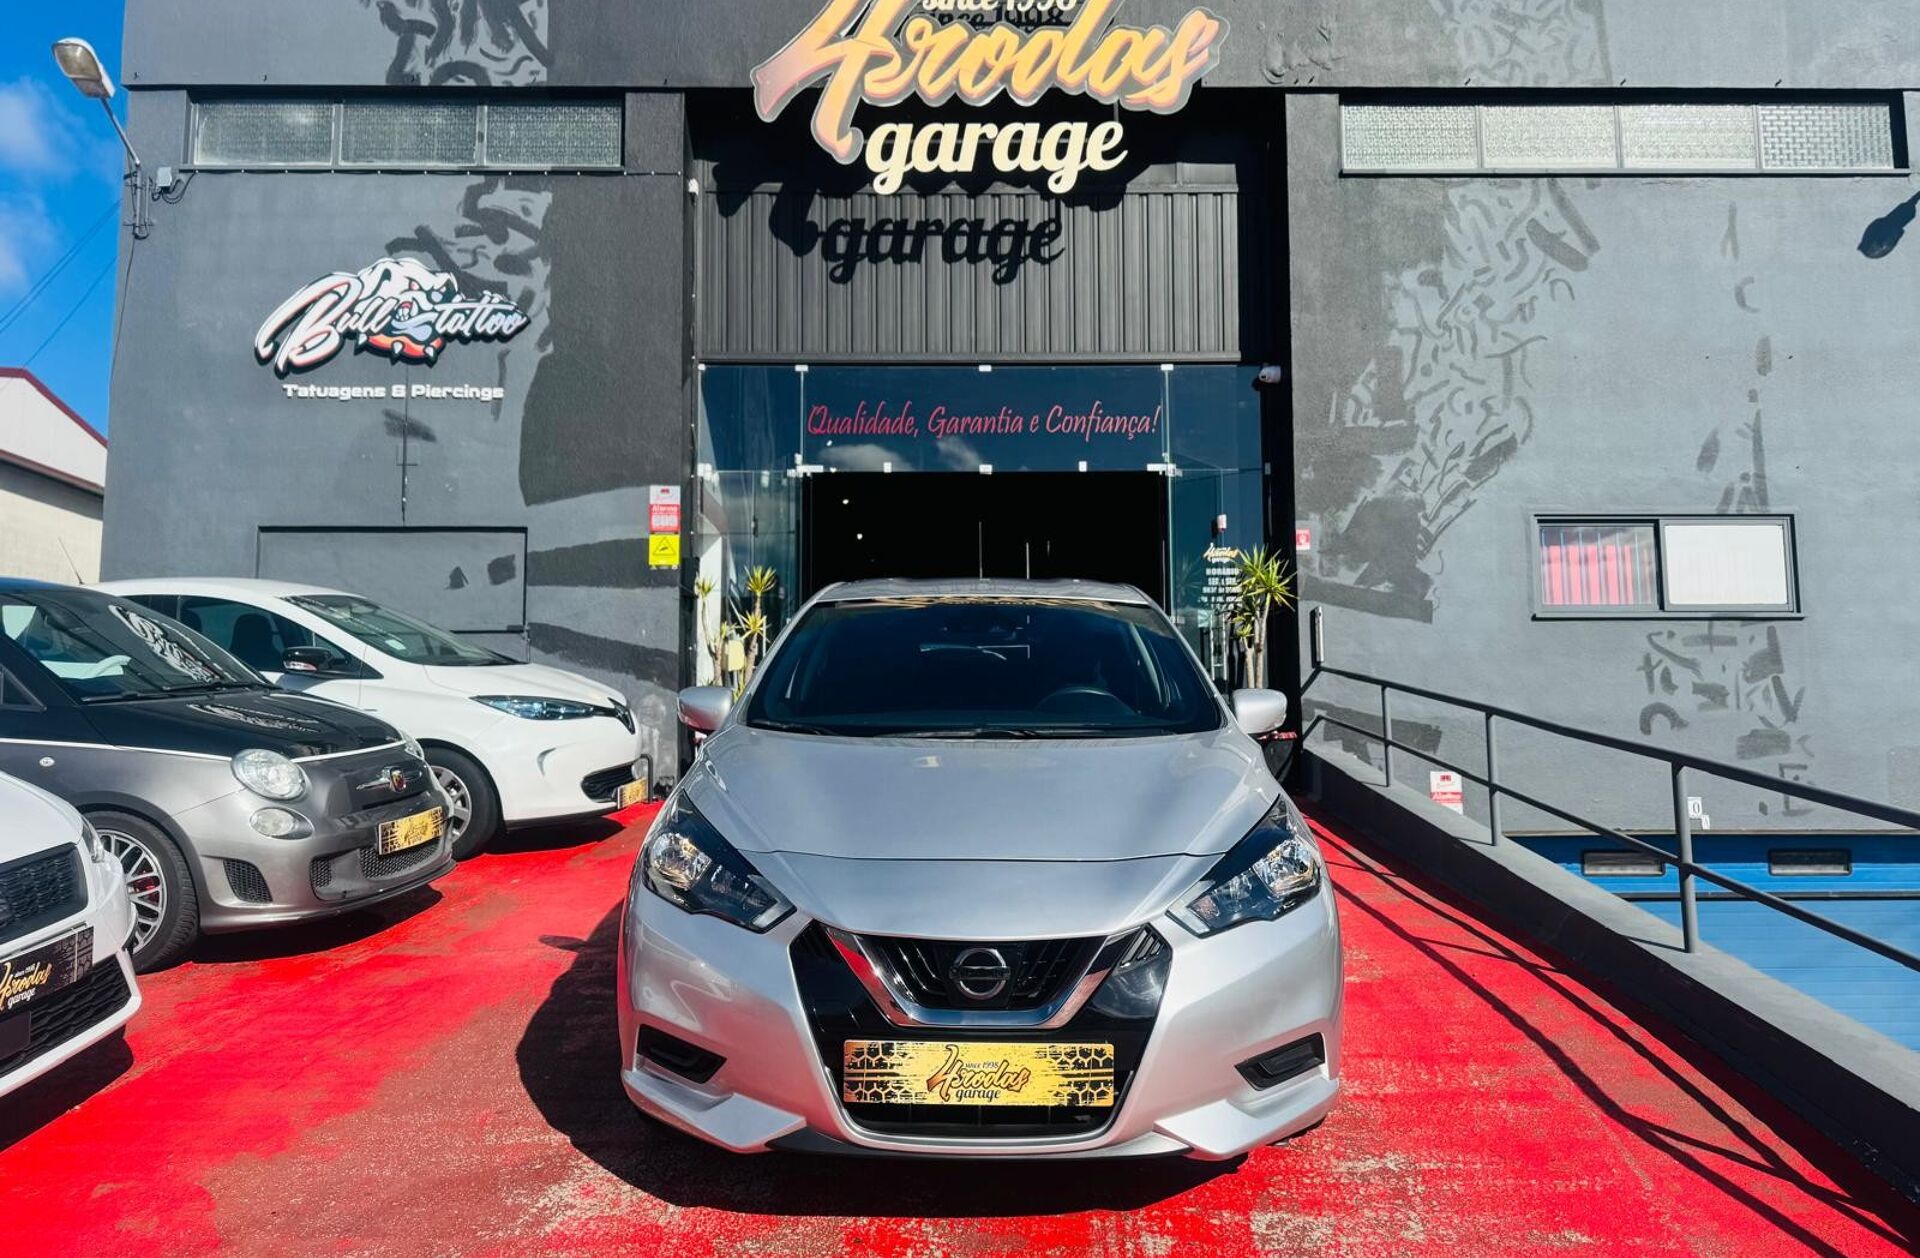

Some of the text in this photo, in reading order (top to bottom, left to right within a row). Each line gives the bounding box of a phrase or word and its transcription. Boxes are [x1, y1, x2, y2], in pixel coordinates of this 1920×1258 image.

[864, 117, 1128, 195] garage
[254, 273, 531, 379] Bull tattoo
[282, 384, 504, 401] Tatuagens & Piercings
[806, 400, 1161, 442] Qualidade, Garantia e Confiança!
[7, 987, 37, 1010] garage
[955, 1088, 1002, 1102] garage
